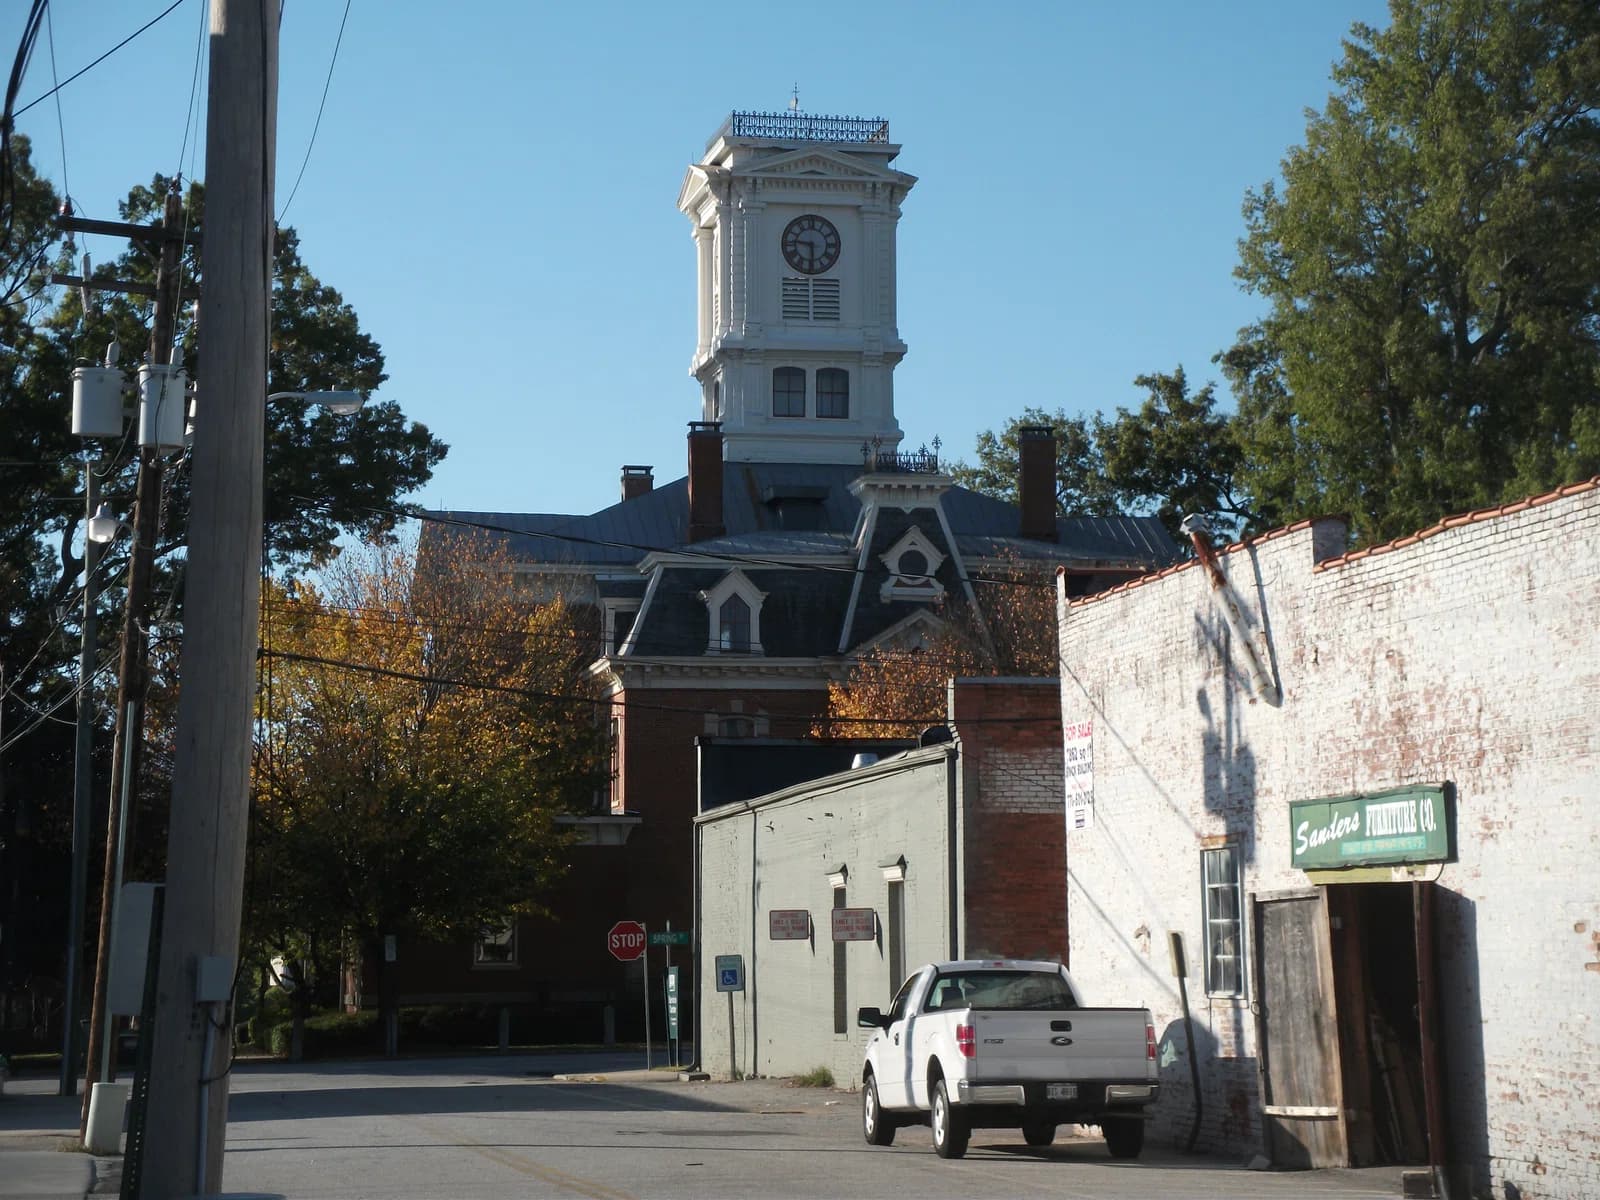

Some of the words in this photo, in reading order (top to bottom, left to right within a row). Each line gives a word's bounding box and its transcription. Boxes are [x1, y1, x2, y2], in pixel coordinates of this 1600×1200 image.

[1078, 721, 1092, 738] SALE
[1295, 811, 1361, 855] Sanders
[1365, 800, 1417, 836] FURNITURE
[1420, 798, 1437, 832] CO.
[612, 933, 644, 948] STOP
[653, 933, 678, 944] SPRING
